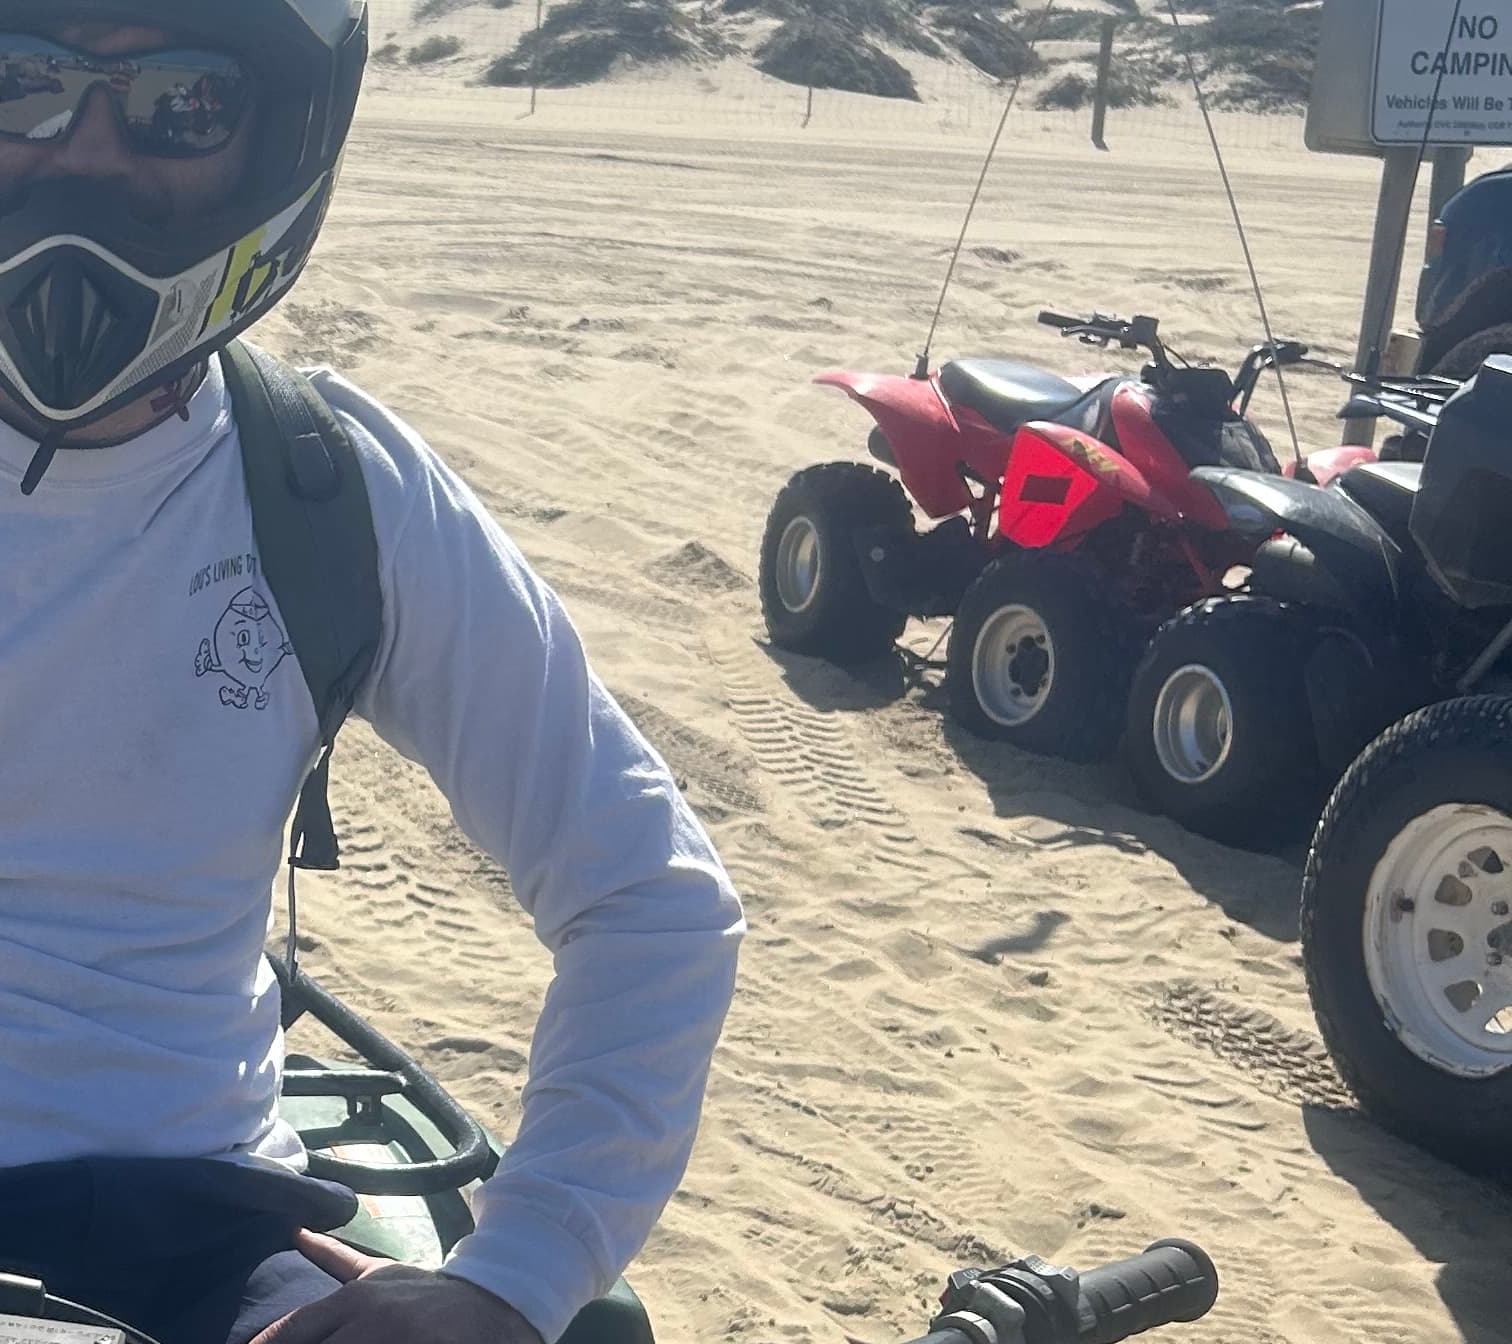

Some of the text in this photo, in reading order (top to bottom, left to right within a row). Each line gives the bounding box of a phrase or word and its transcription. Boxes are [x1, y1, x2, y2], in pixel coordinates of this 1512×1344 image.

[1458, 15, 1498, 39] NO
[1410, 51, 1512, 75] CAMPIN
[1452, 96, 1479, 111] Will
[1484, 97, 1504, 111] Be
[214, 555, 242, 583] LIVING
